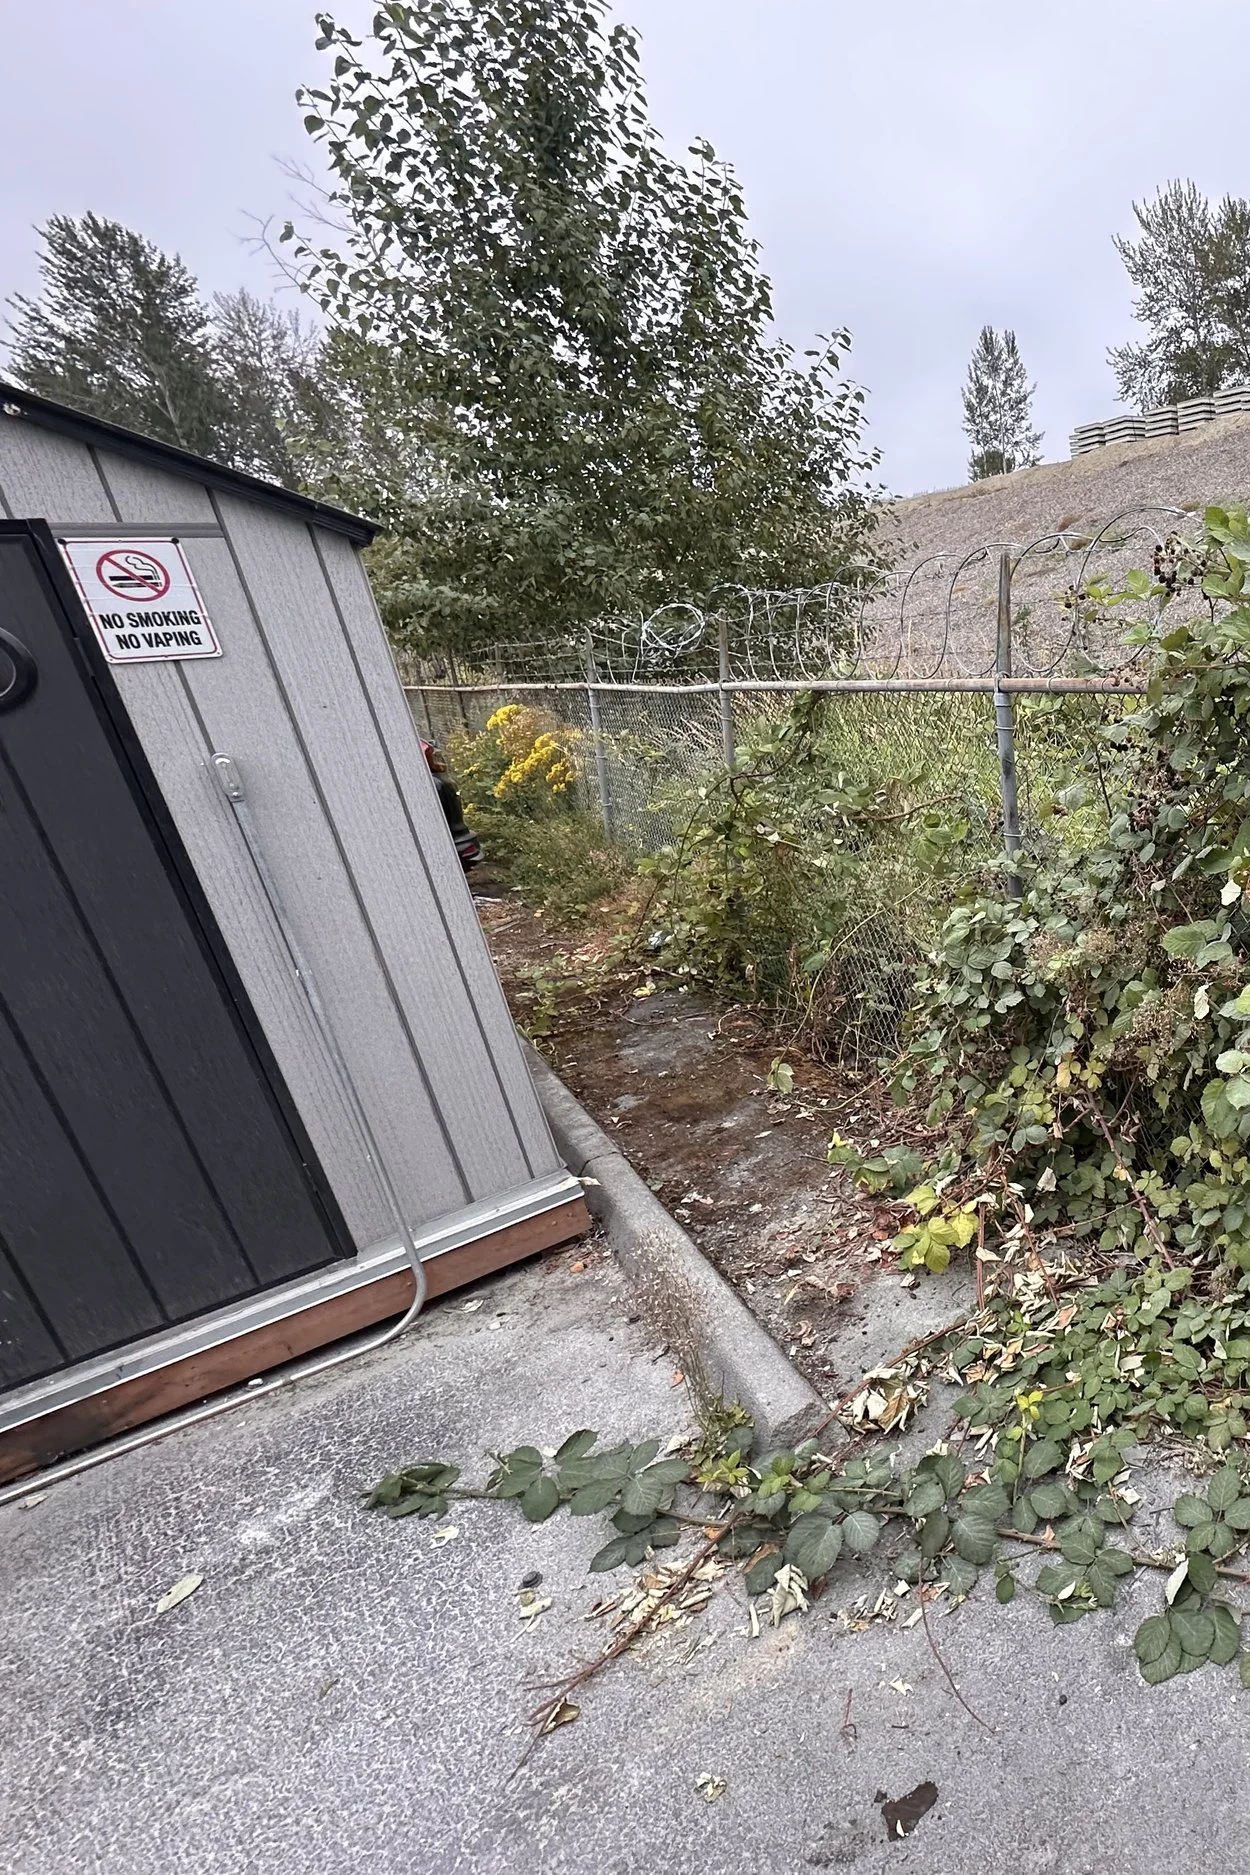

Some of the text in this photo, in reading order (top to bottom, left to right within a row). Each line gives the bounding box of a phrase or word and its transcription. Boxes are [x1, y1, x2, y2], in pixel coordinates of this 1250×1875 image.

[99, 610, 202, 630] NO SMOKING
[115, 630, 203, 650] NO VAPING
